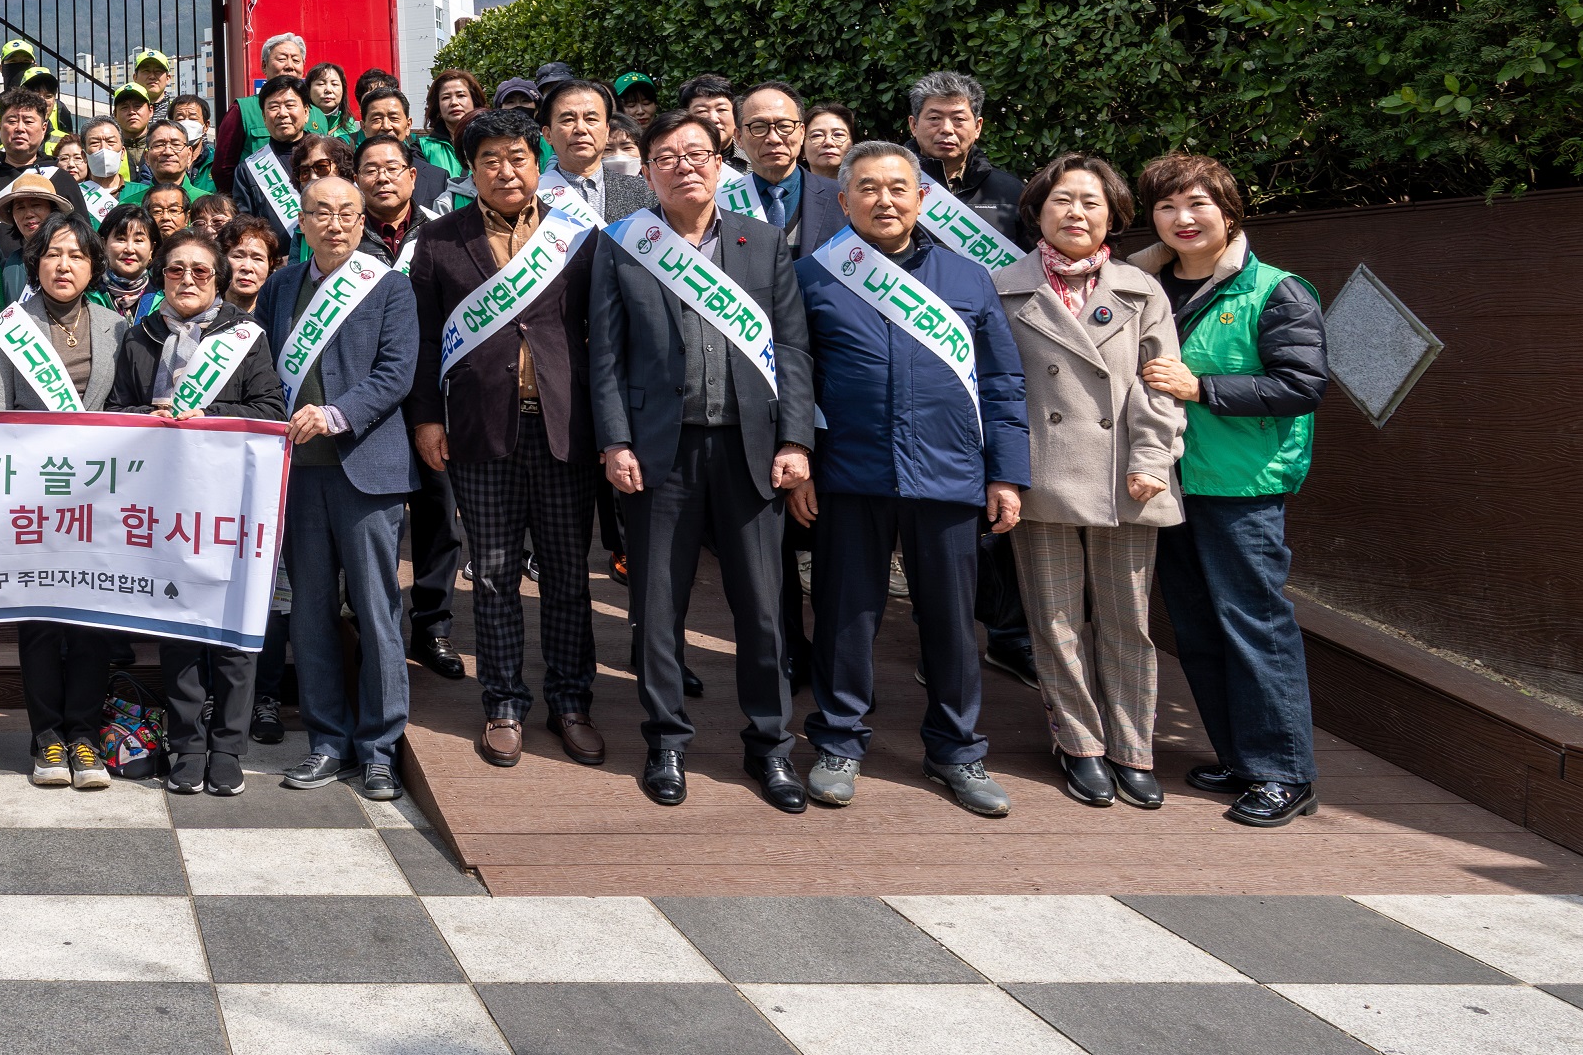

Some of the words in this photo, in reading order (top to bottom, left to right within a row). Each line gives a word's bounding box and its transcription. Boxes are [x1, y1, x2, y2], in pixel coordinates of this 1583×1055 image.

[254, 156, 303, 220] 도시환경
[284, 276, 356, 376] 도시환경
[462, 246, 552, 333] 도시환경
[657, 247, 763, 342] 도시환경
[864, 267, 970, 363] 도시환경
[173, 339, 234, 417] 도시환
[9, 503, 95, 547] 함께
[121, 504, 265, 559] 합시다!
[17, 570, 156, 599] 주민자치연합회
